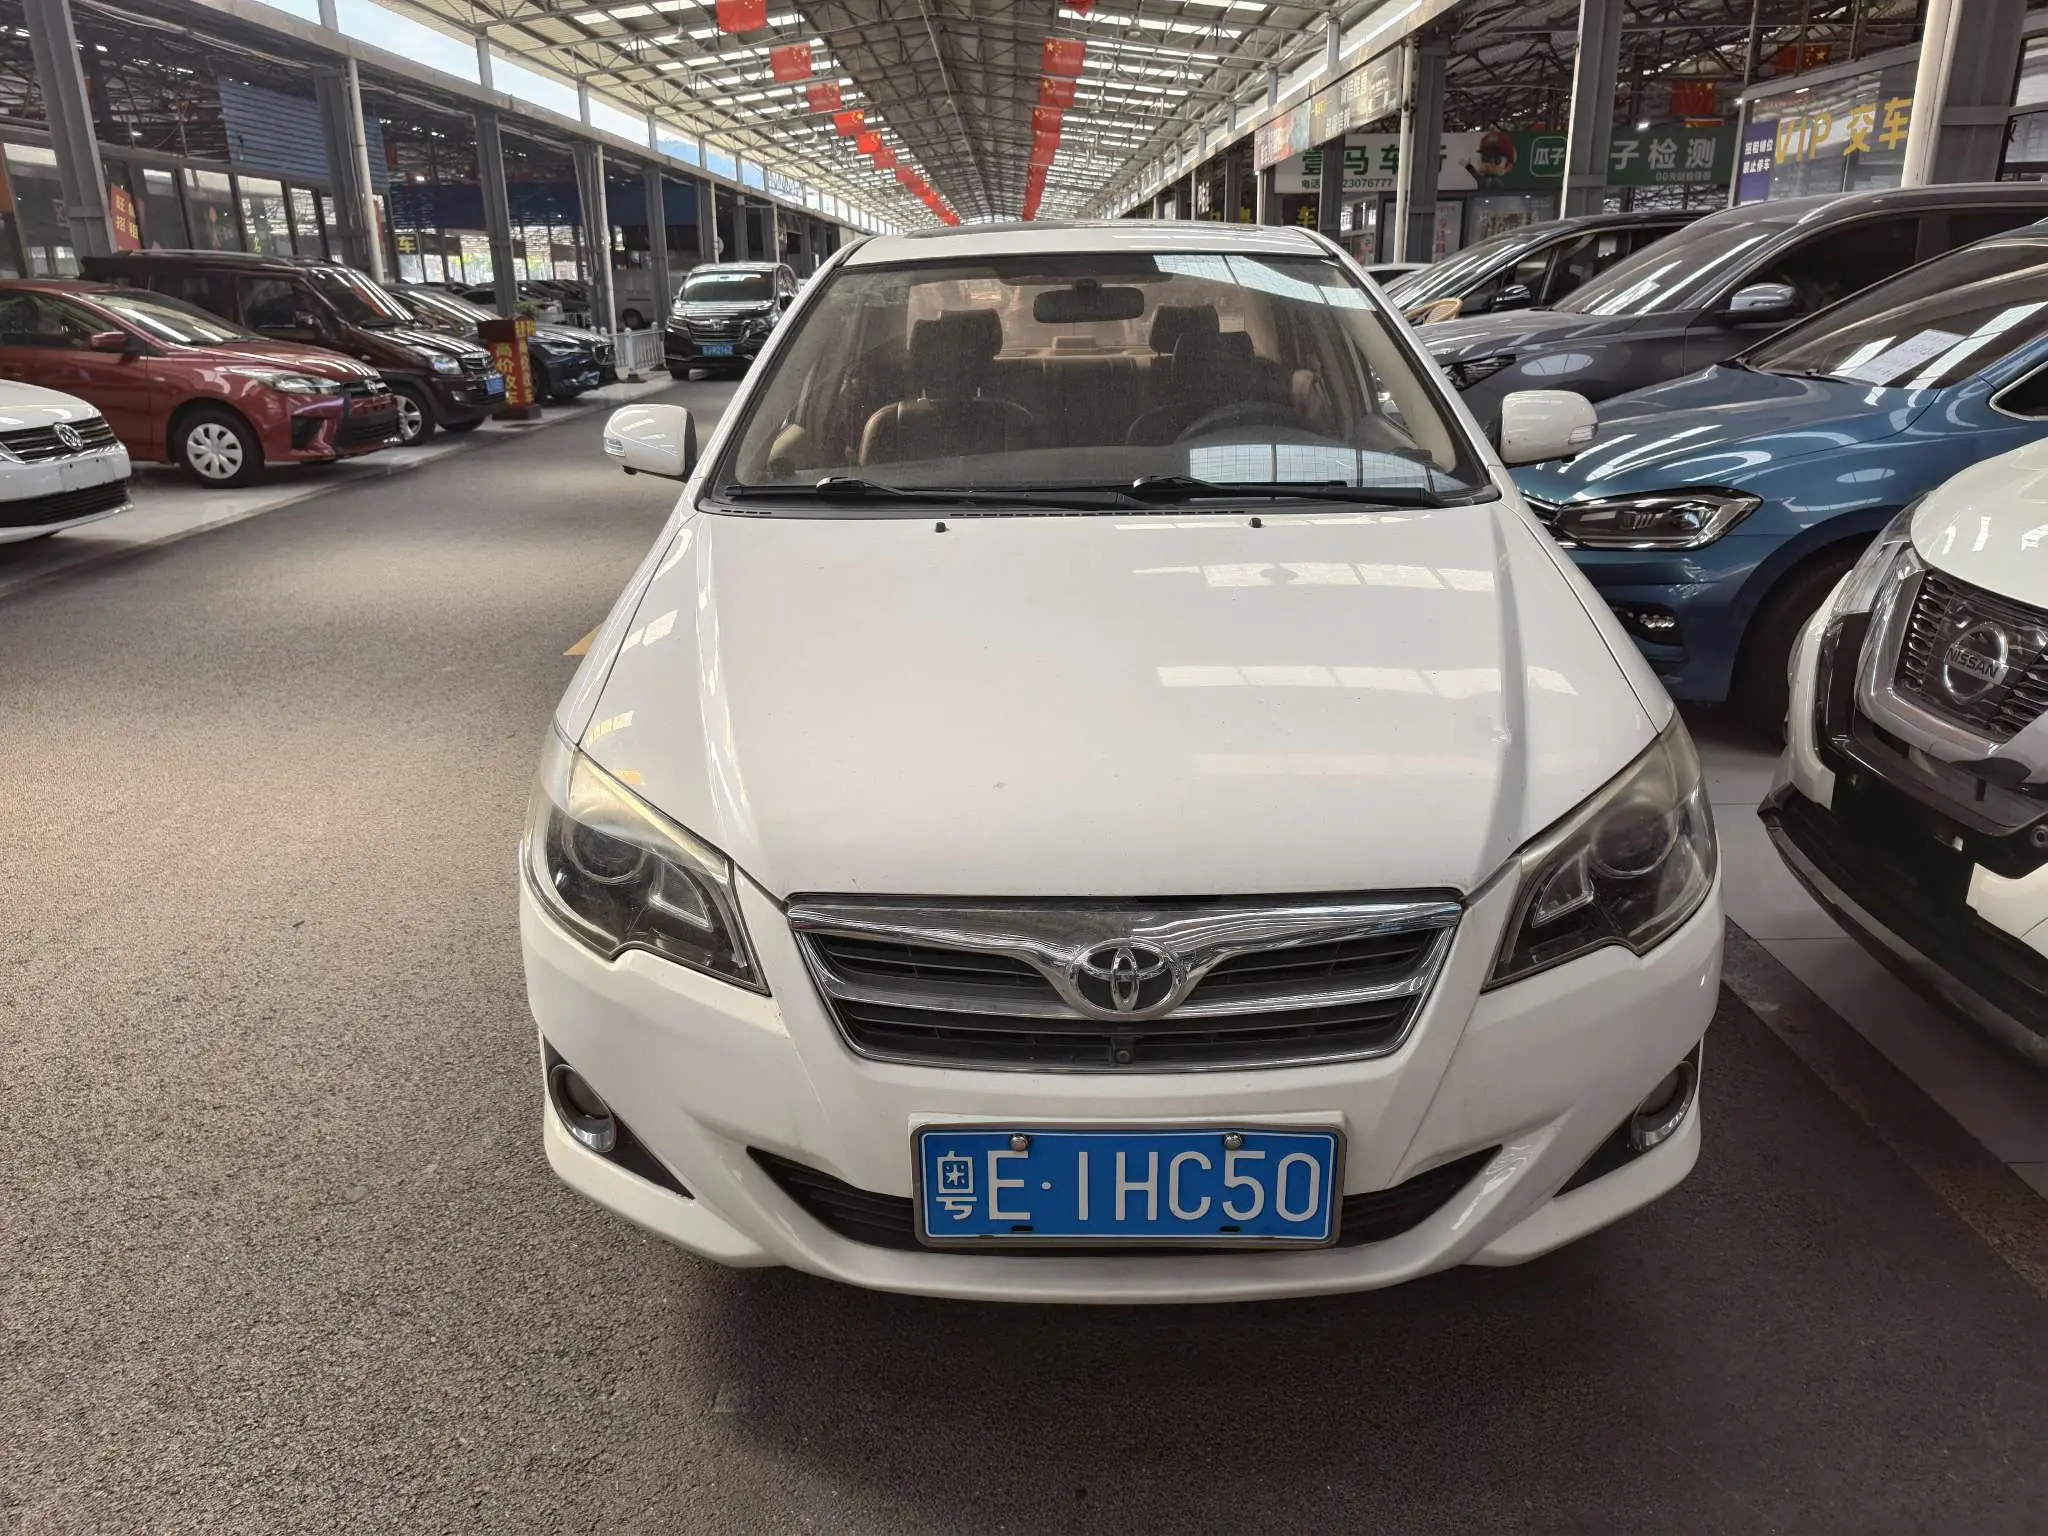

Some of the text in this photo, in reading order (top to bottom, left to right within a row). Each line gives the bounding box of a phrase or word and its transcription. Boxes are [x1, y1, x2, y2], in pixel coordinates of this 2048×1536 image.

[1775, 96, 1913, 165] VIP 交车
[1534, 147, 1565, 166] 瓜子
[398, 235, 417, 254] 车
[1948, 647, 1999, 678] NISSAN
